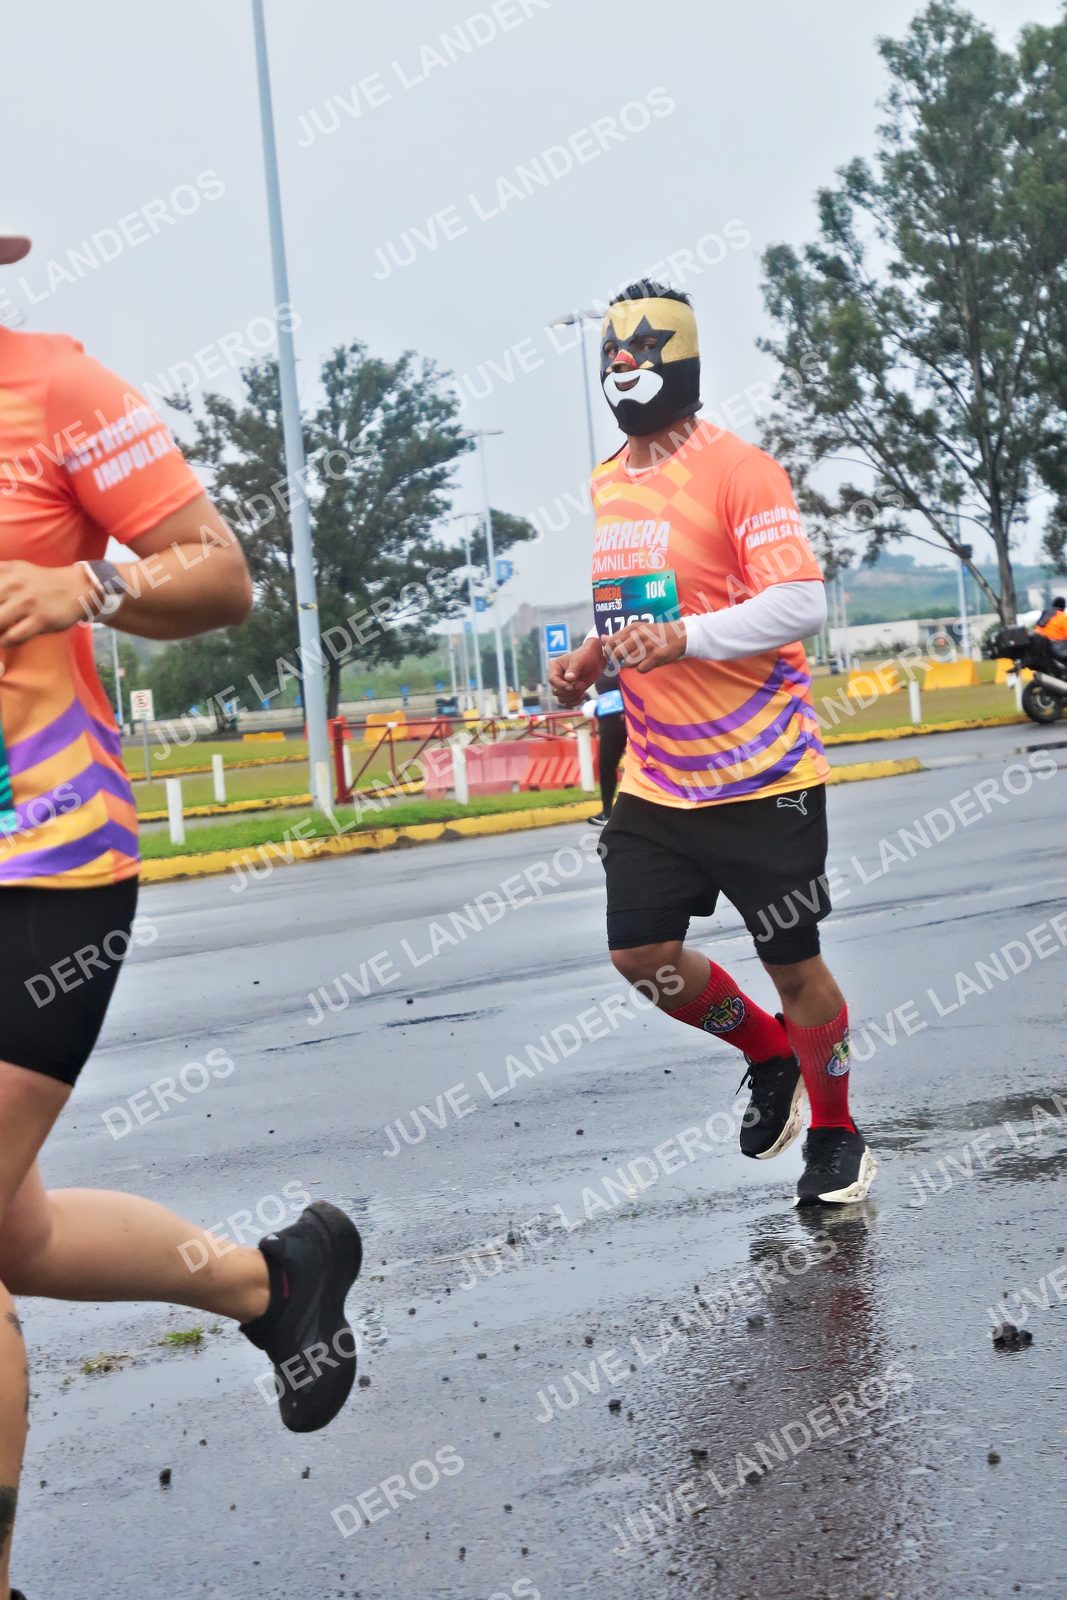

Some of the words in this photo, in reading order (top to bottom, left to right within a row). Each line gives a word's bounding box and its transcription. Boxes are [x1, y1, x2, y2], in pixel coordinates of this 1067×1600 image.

[592, 552, 646, 575] OMNILIFE
[644, 580, 667, 599] 10K
[604, 612, 655, 637] 17
